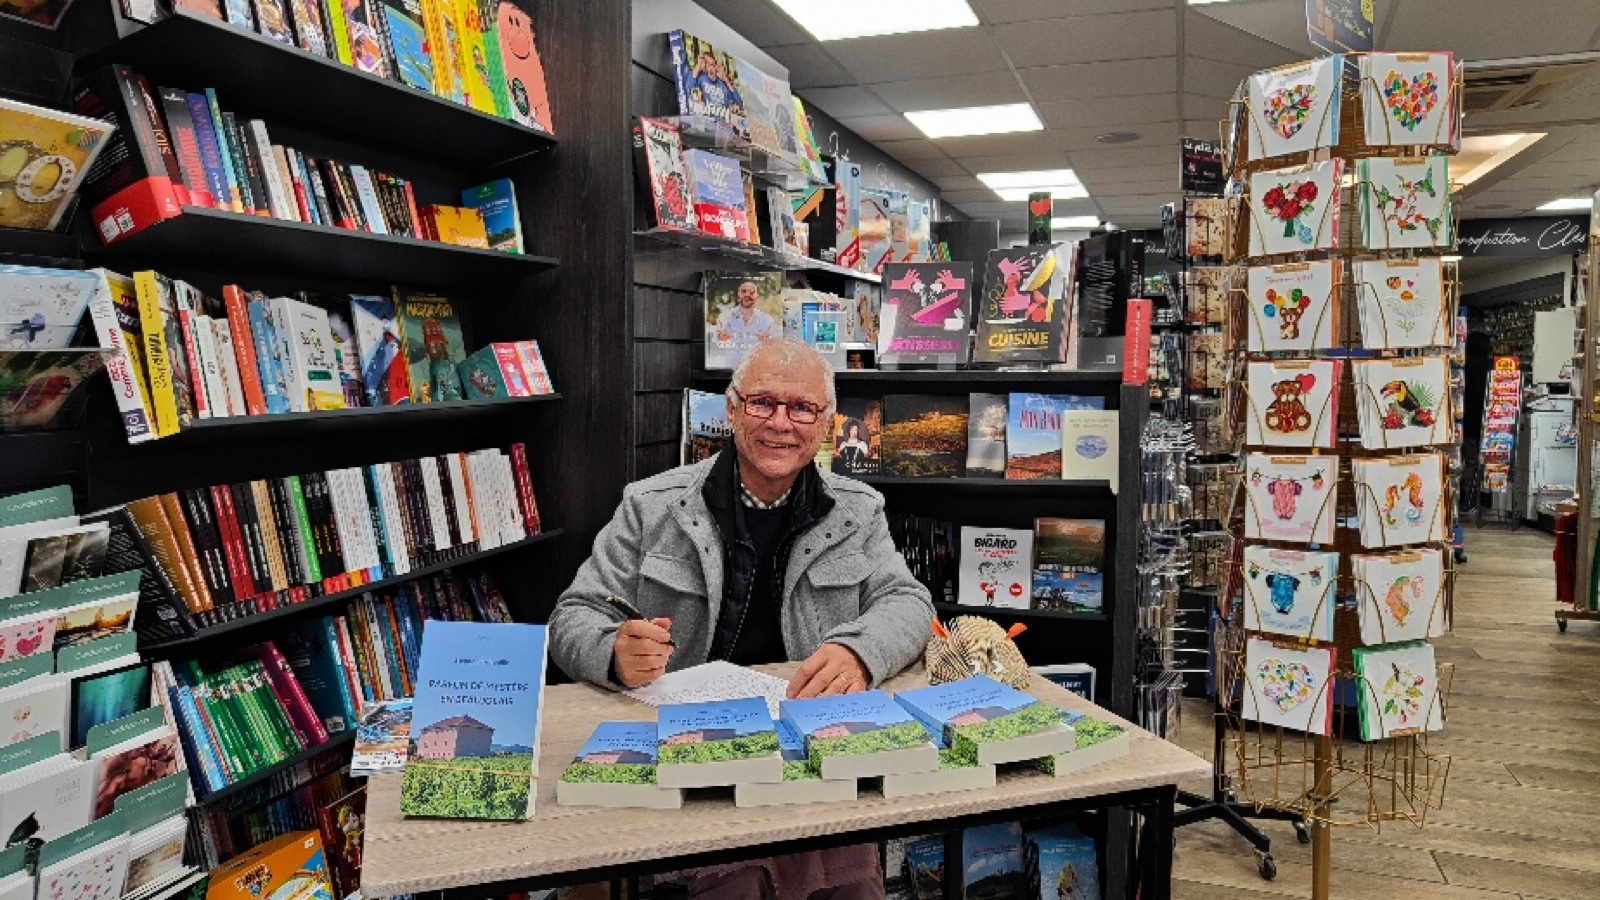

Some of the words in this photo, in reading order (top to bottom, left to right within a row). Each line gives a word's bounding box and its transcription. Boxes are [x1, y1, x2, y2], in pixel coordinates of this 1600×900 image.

[988, 331, 1050, 347] CUISINE
[974, 537, 1017, 549] BIGARD
[429, 679, 469, 690] PARFUM
[470, 681, 484, 690] DE
[440, 695, 453, 704] EN
[455, 695, 514, 705] BEAUJOLAIS
